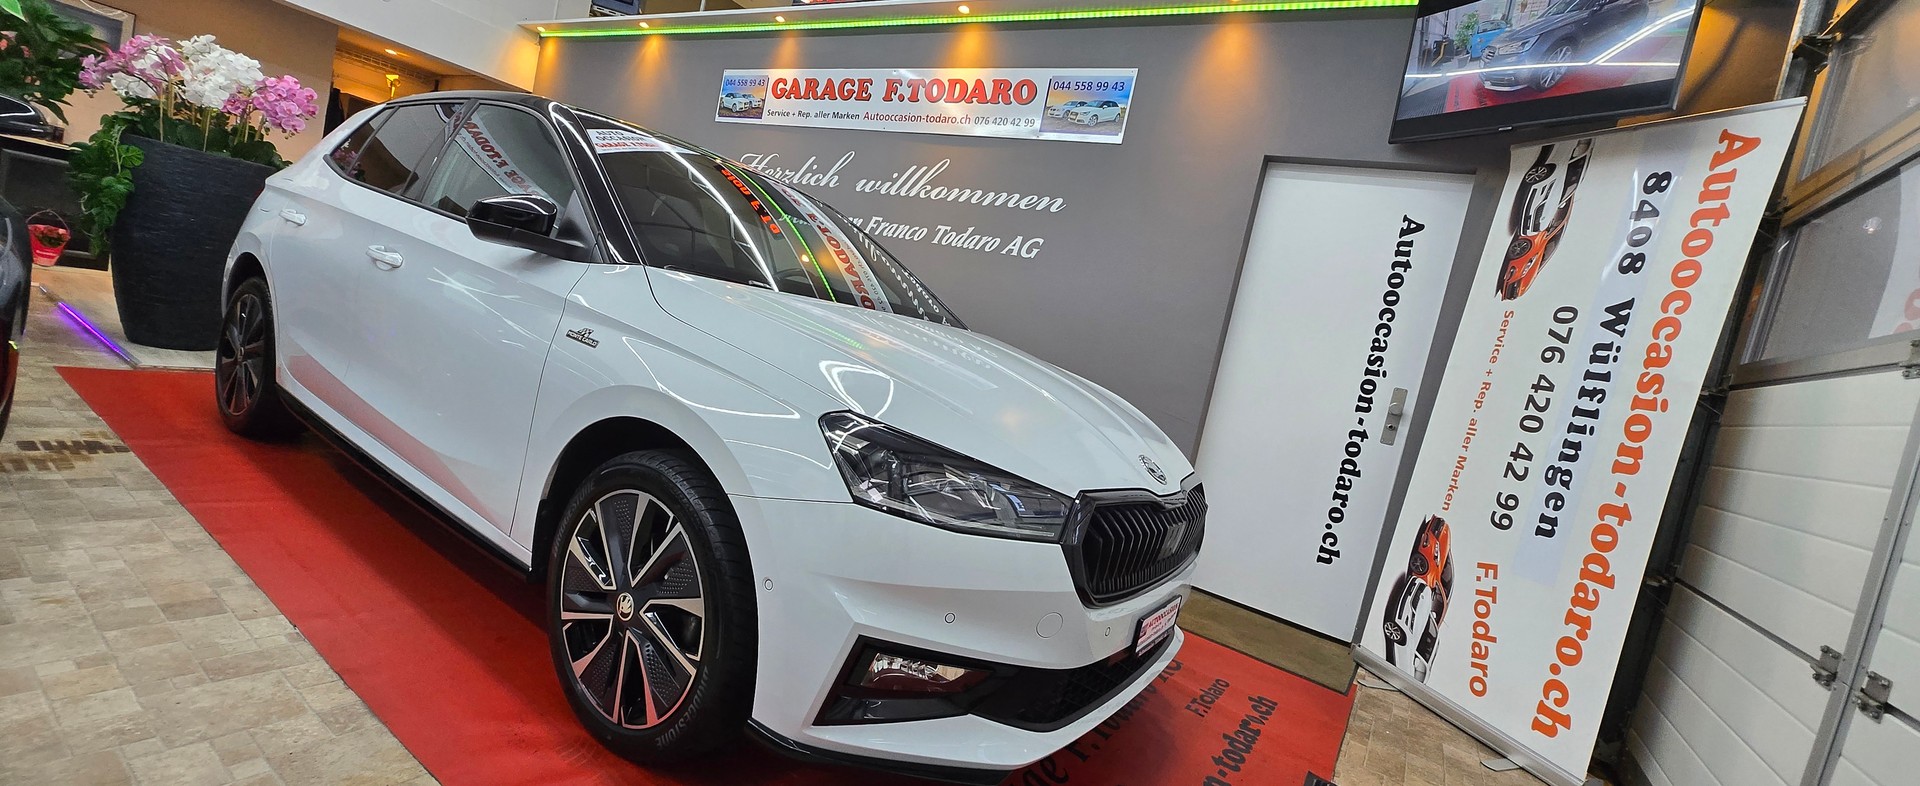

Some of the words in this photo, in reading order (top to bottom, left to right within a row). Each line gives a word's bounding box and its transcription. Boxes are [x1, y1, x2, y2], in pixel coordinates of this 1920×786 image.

[725, 79, 736, 87] 044
[737, 79, 748, 87] 558
[771, 77, 873, 102] GARAGE
[882, 78, 1038, 106] F.TODARO
[1053, 81, 1071, 91] 044
[1074, 81, 1093, 91] 558
[1095, 81, 1109, 91] 99
[1111, 81, 1125, 92] 43
[767, 109, 790, 117] Service
[797, 111, 812, 119] Rep.
[814, 110, 830, 119] aller
[831, 111, 860, 120] Marken
[863, 111, 971, 125] Autooccasion-todaro.ch
[974, 116, 990, 125] 076
[992, 117, 1008, 126] 420
[1011, 117, 1022, 127] 42
[1024, 118, 1036, 128] 99
[740, 151, 855, 188] Herzlich
[855, 158, 1067, 213] willkommen
[864, 216, 928, 241] Franco
[931, 223, 1002, 253] Todaro
[1001, 235, 1044, 259] AG
[1618, 170, 1672, 275] 8408
[1489, 310, 1514, 364] Service
[1540, 305, 1579, 364] 076
[1316, 214, 1426, 565] Autooccasion-todaro.ch
[1473, 381, 1492, 413] Rep.
[1519, 374, 1556, 434] 420
[1462, 418, 1478, 452] aller
[1531, 128, 1761, 738] Autooccasion-todaro.ch
[1535, 297, 1635, 539] Wülflingen
[1442, 456, 1468, 511] Marken
[1503, 442, 1534, 482] 42
[1490, 491, 1519, 531] 99
[1469, 562, 1499, 697] F.Todaro
